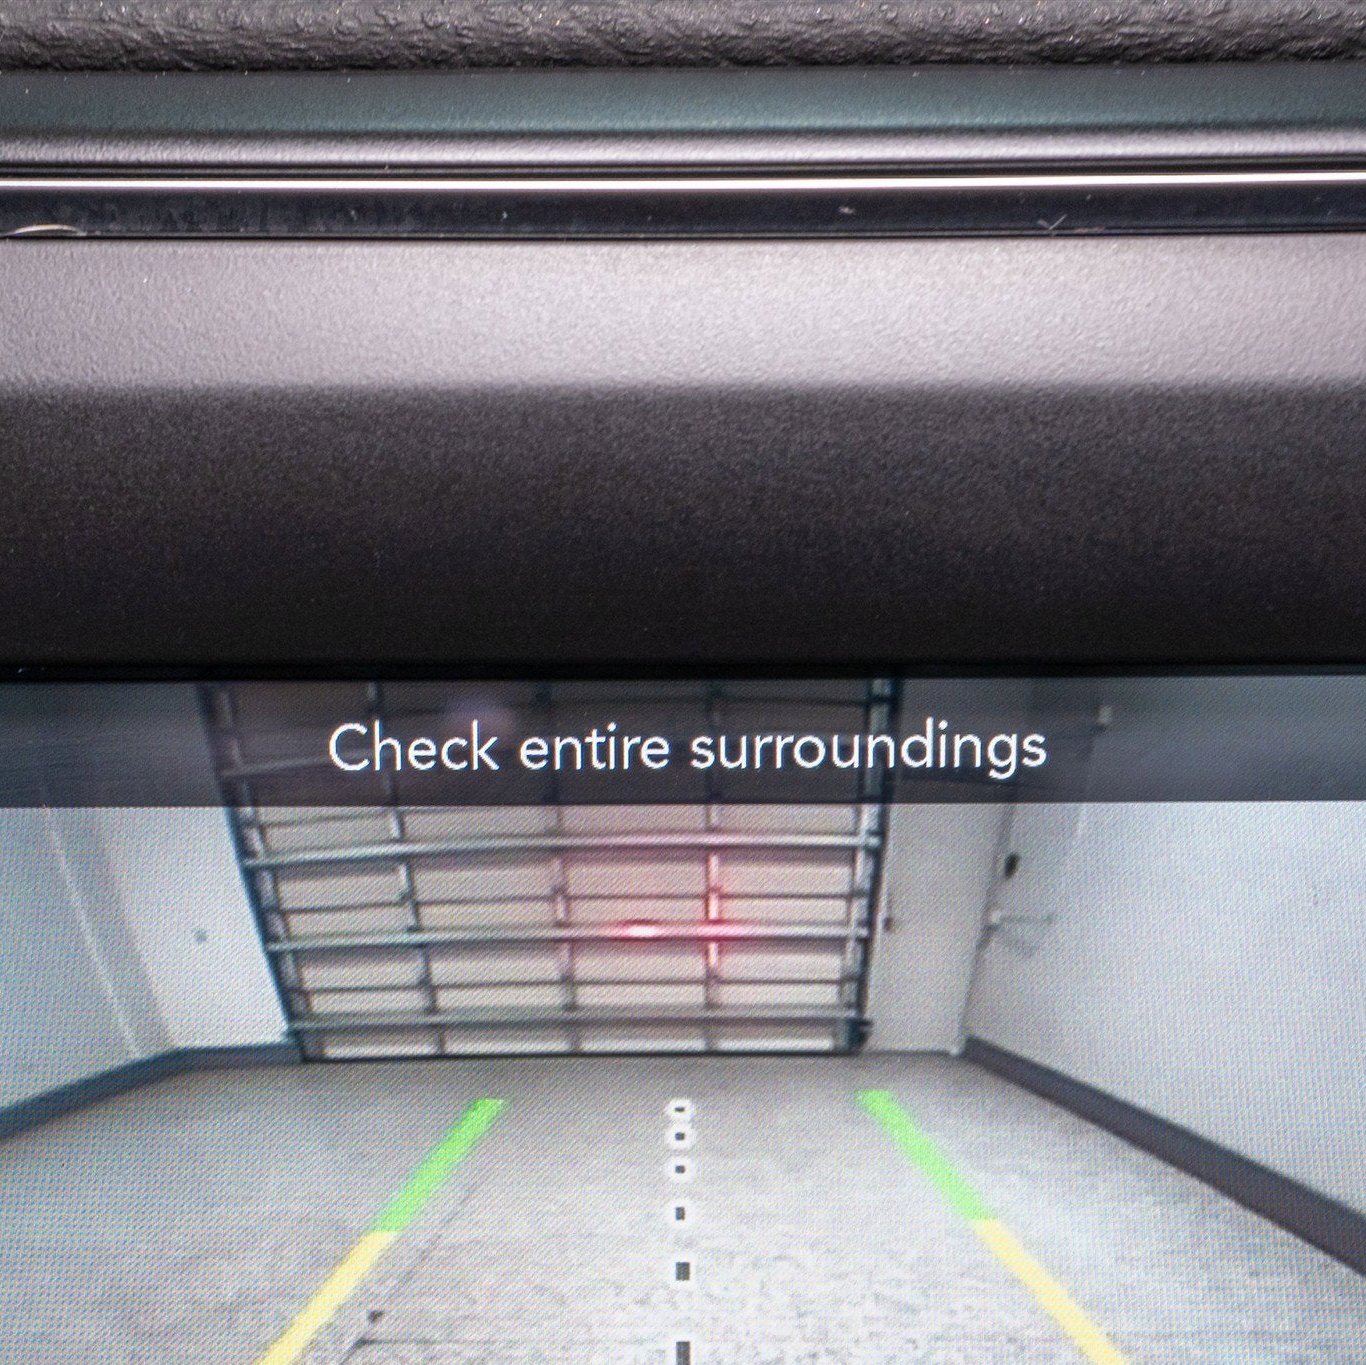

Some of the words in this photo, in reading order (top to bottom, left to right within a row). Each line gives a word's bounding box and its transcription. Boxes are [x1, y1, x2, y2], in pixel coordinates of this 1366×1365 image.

[328, 720, 501, 772] Check
[519, 722, 670, 772] entire
[691, 716, 1047, 781] surroundings
